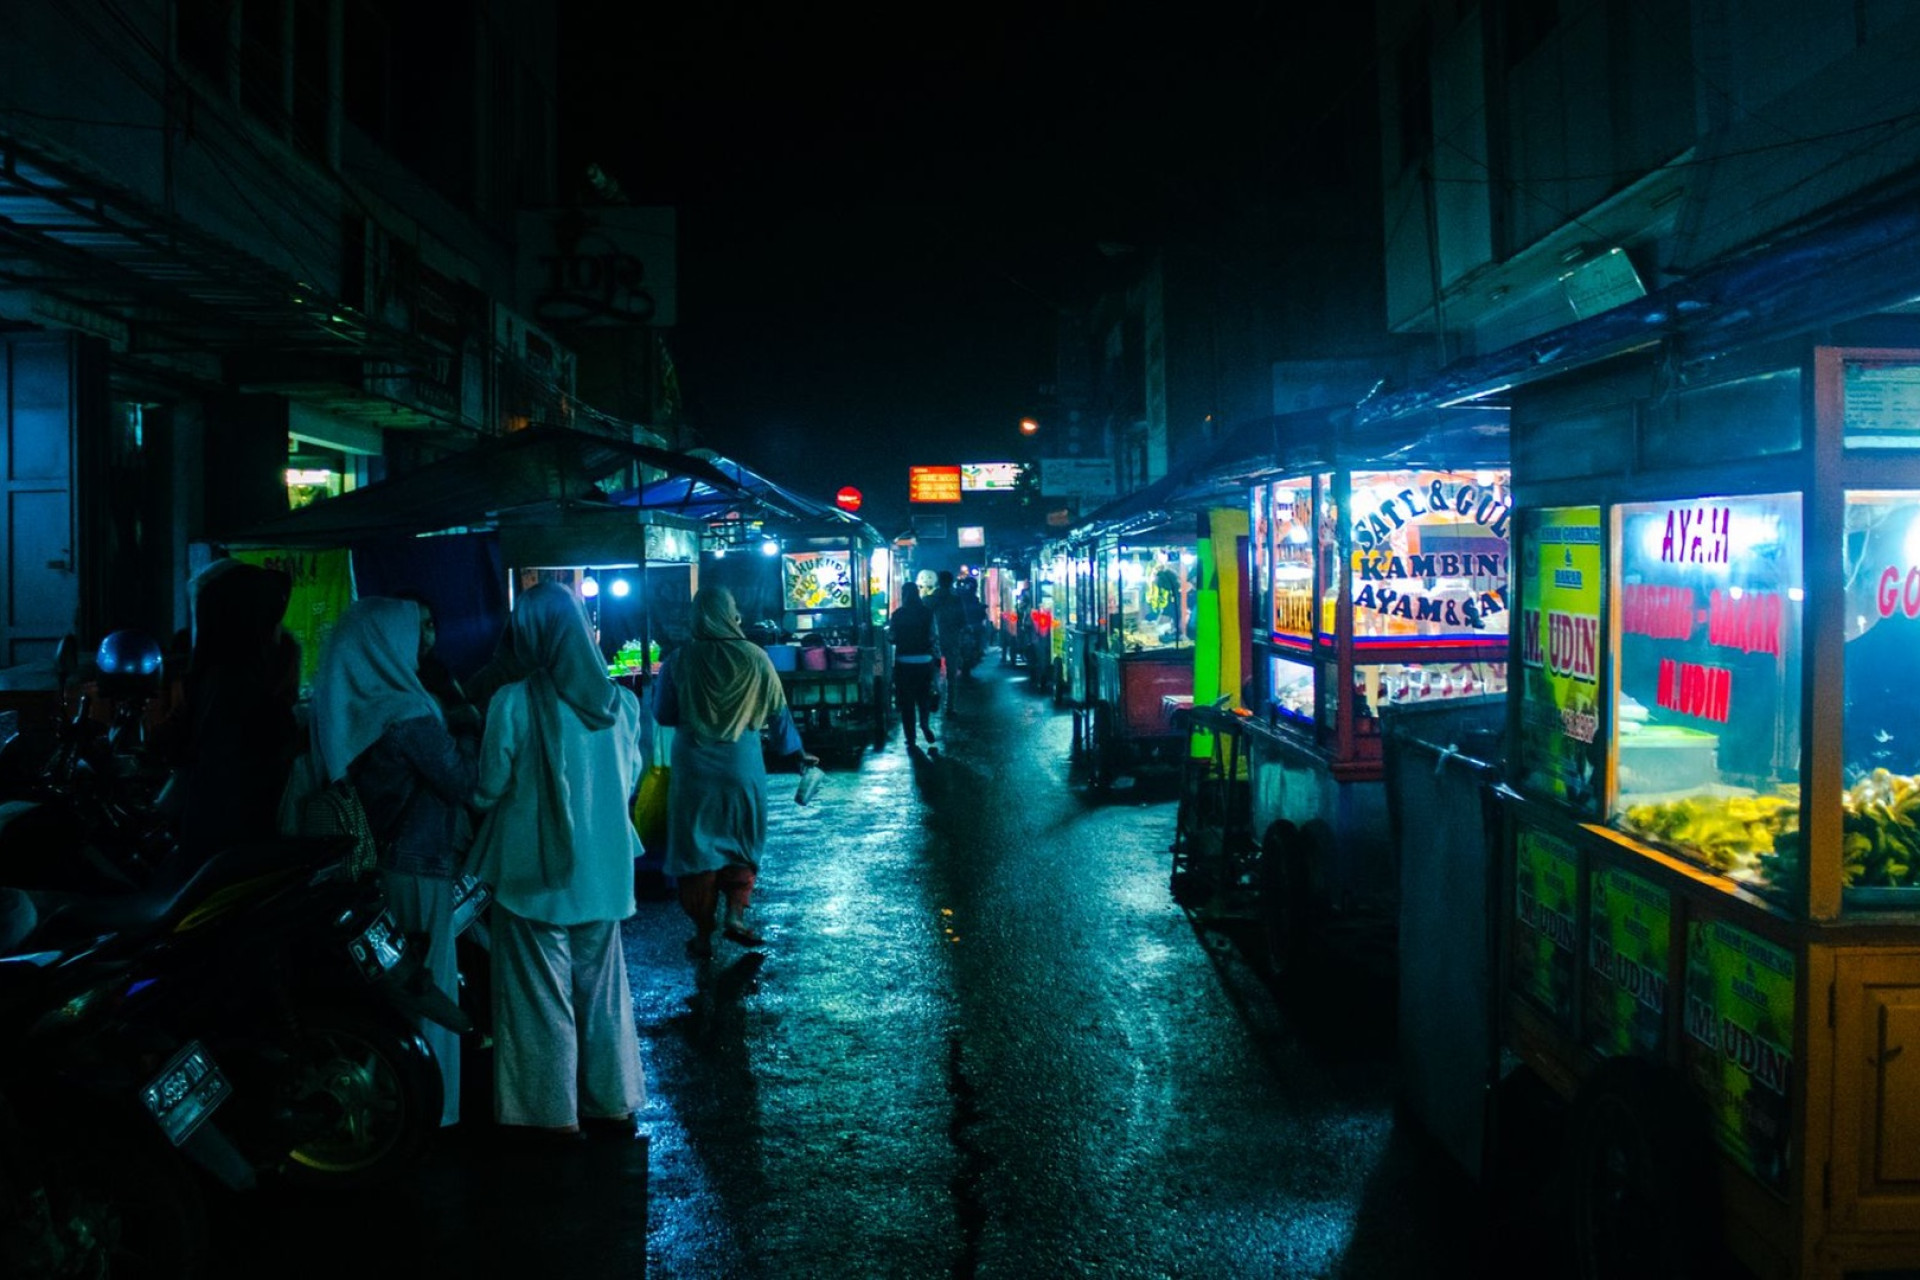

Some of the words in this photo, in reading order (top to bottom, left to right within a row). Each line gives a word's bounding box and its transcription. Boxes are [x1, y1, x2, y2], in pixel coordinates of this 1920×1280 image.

[1354, 488, 1428, 554] SATE
[1430, 479, 1449, 511] &
[1662, 507, 1730, 563] AYAM
[1360, 553, 1508, 581] KAMBIN
[1355, 584, 1441, 622] AYAM
[1548, 610, 1597, 682] UDIN
[1722, 1018, 1789, 1096] UDIN
